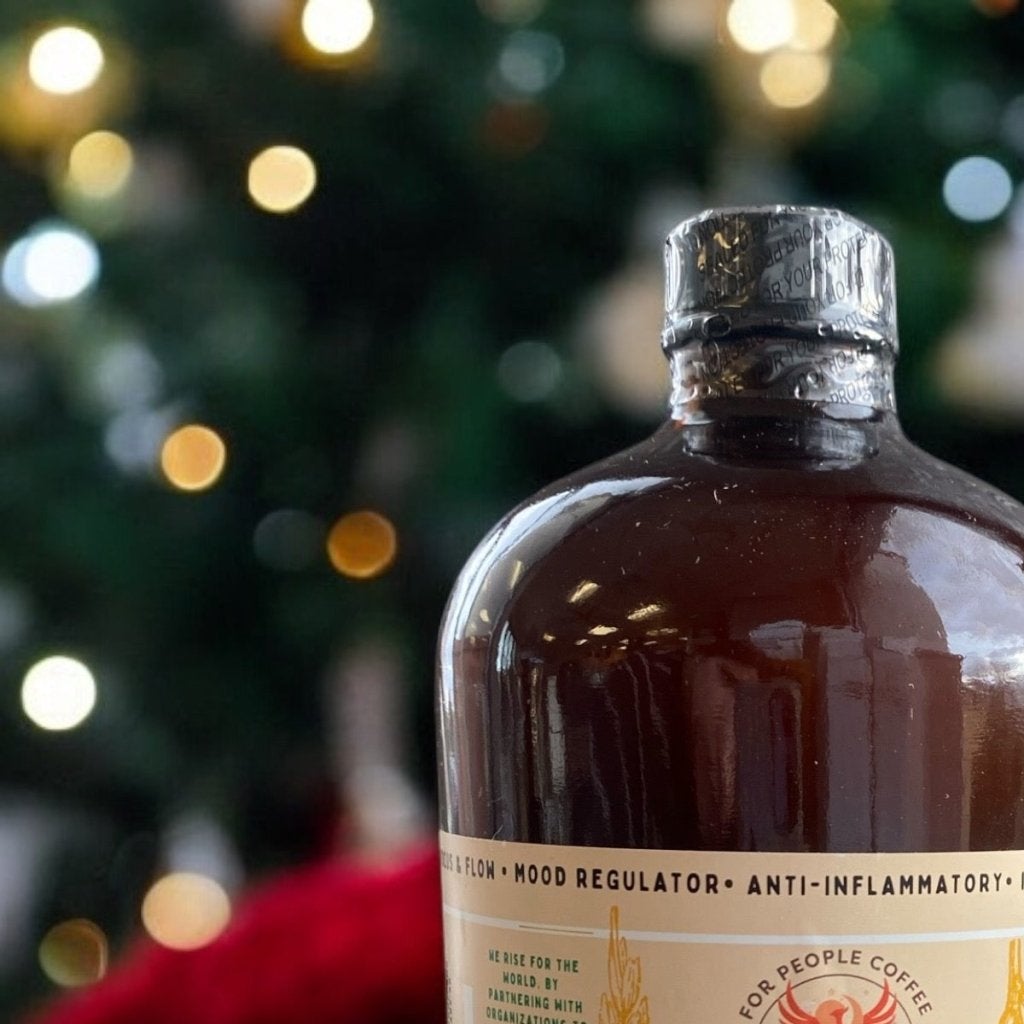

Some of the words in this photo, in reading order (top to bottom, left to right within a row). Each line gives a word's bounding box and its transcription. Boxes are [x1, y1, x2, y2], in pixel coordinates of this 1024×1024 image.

[466, 859, 495, 880] FLOW
[514, 862, 566, 886] MOOD
[576, 867, 719, 894] REGULATOR
[748, 872, 1002, 896] ANTI-INFLAMMATORY
[489, 949, 501, 963] WE
[504, 953, 525, 967] RISE
[530, 955, 551, 970] FOR
[557, 959, 579, 973] THE
[545, 977, 558, 991] BY
[739, 979, 775, 1020] FOR
[777, 949, 862, 981] PEOPLE
[870, 956, 932, 1017] COFFEE
[489, 988, 550, 1010] PARTNERING
[555, 997, 583, 1013] WITH
